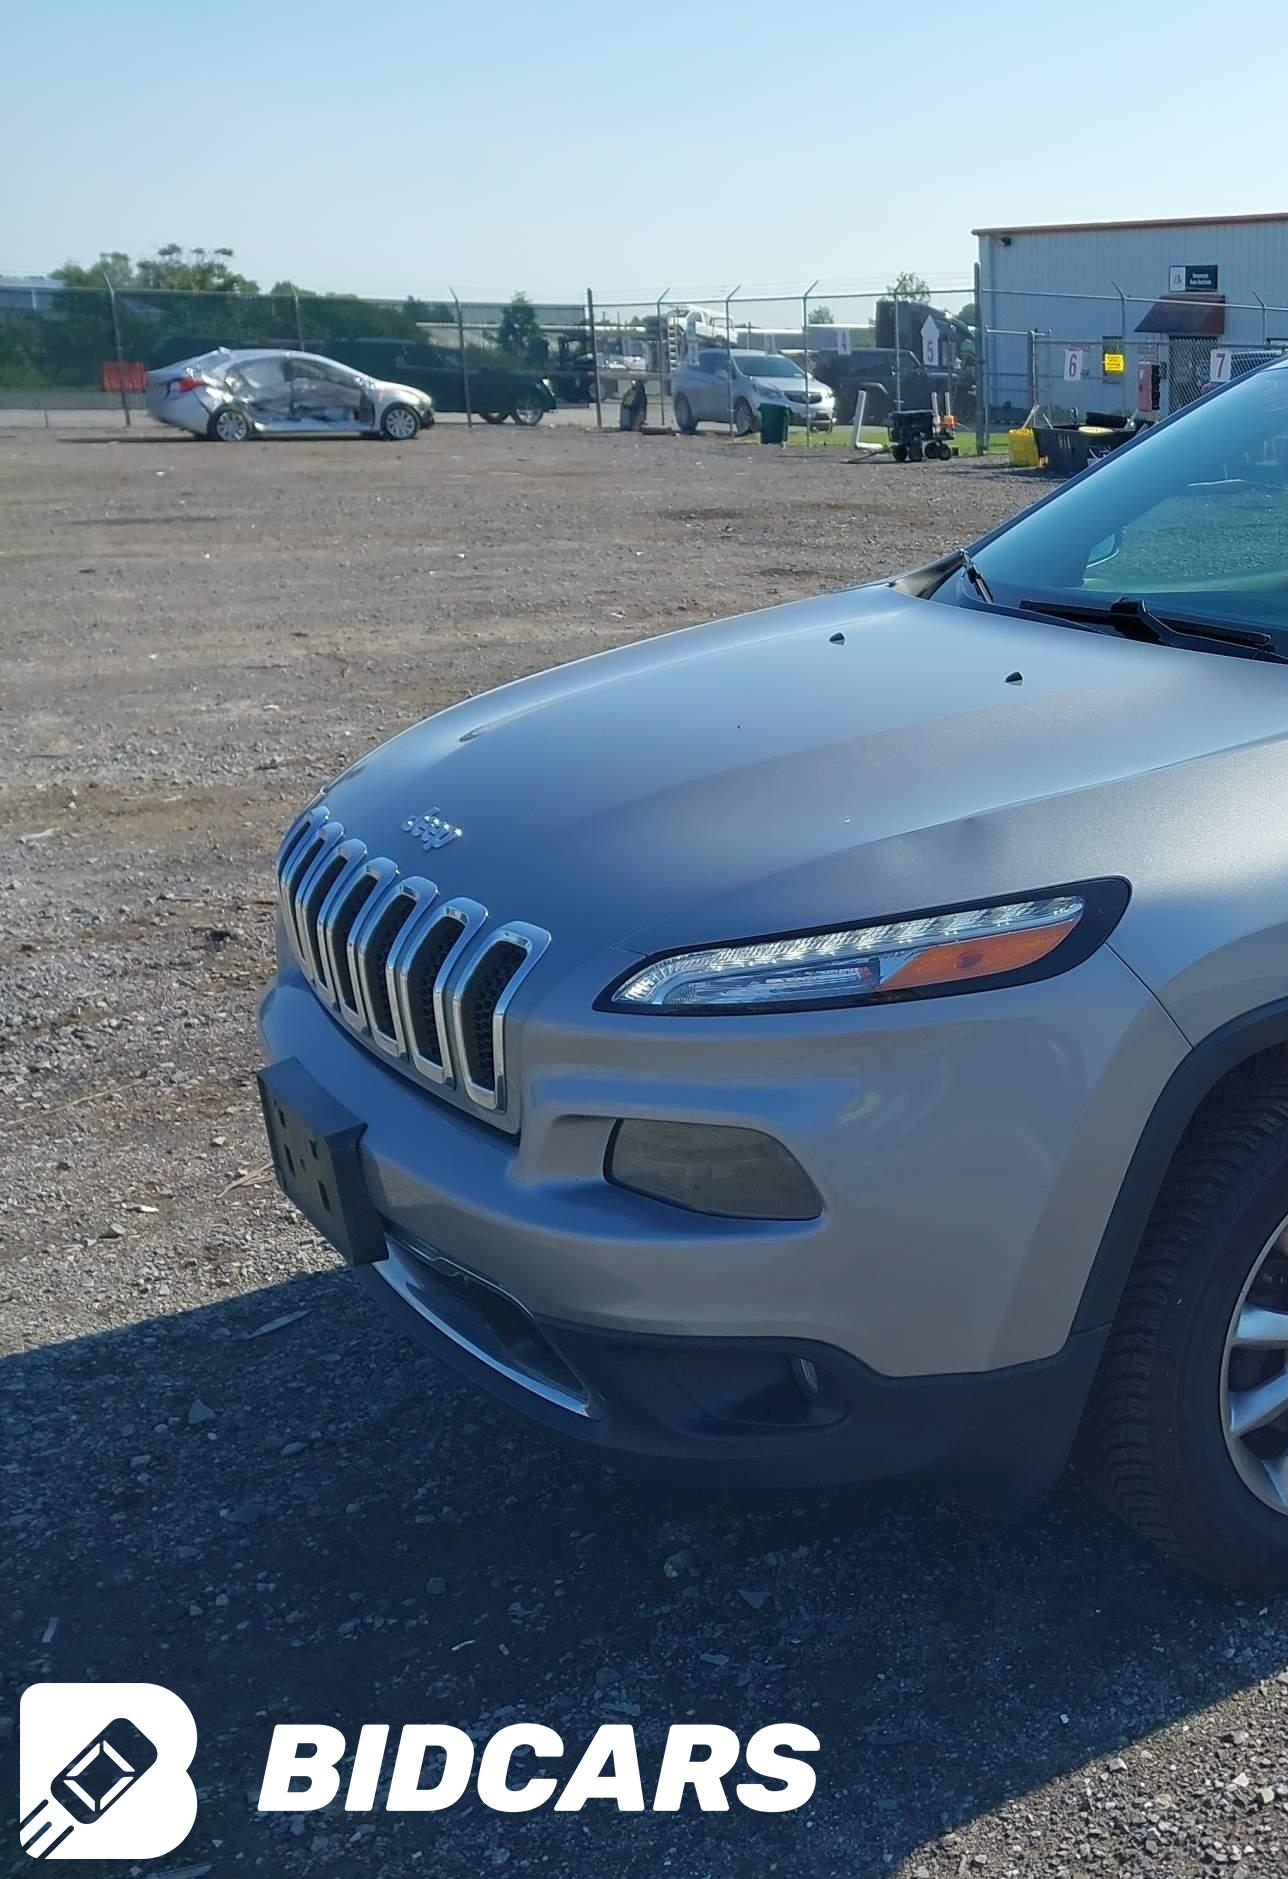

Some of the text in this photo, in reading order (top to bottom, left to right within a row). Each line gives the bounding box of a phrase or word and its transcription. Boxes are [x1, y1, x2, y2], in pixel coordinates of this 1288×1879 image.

[927, 340, 935, 362] 5
[1068, 352, 1078, 378] 6
[1216, 352, 1226, 379] 7
